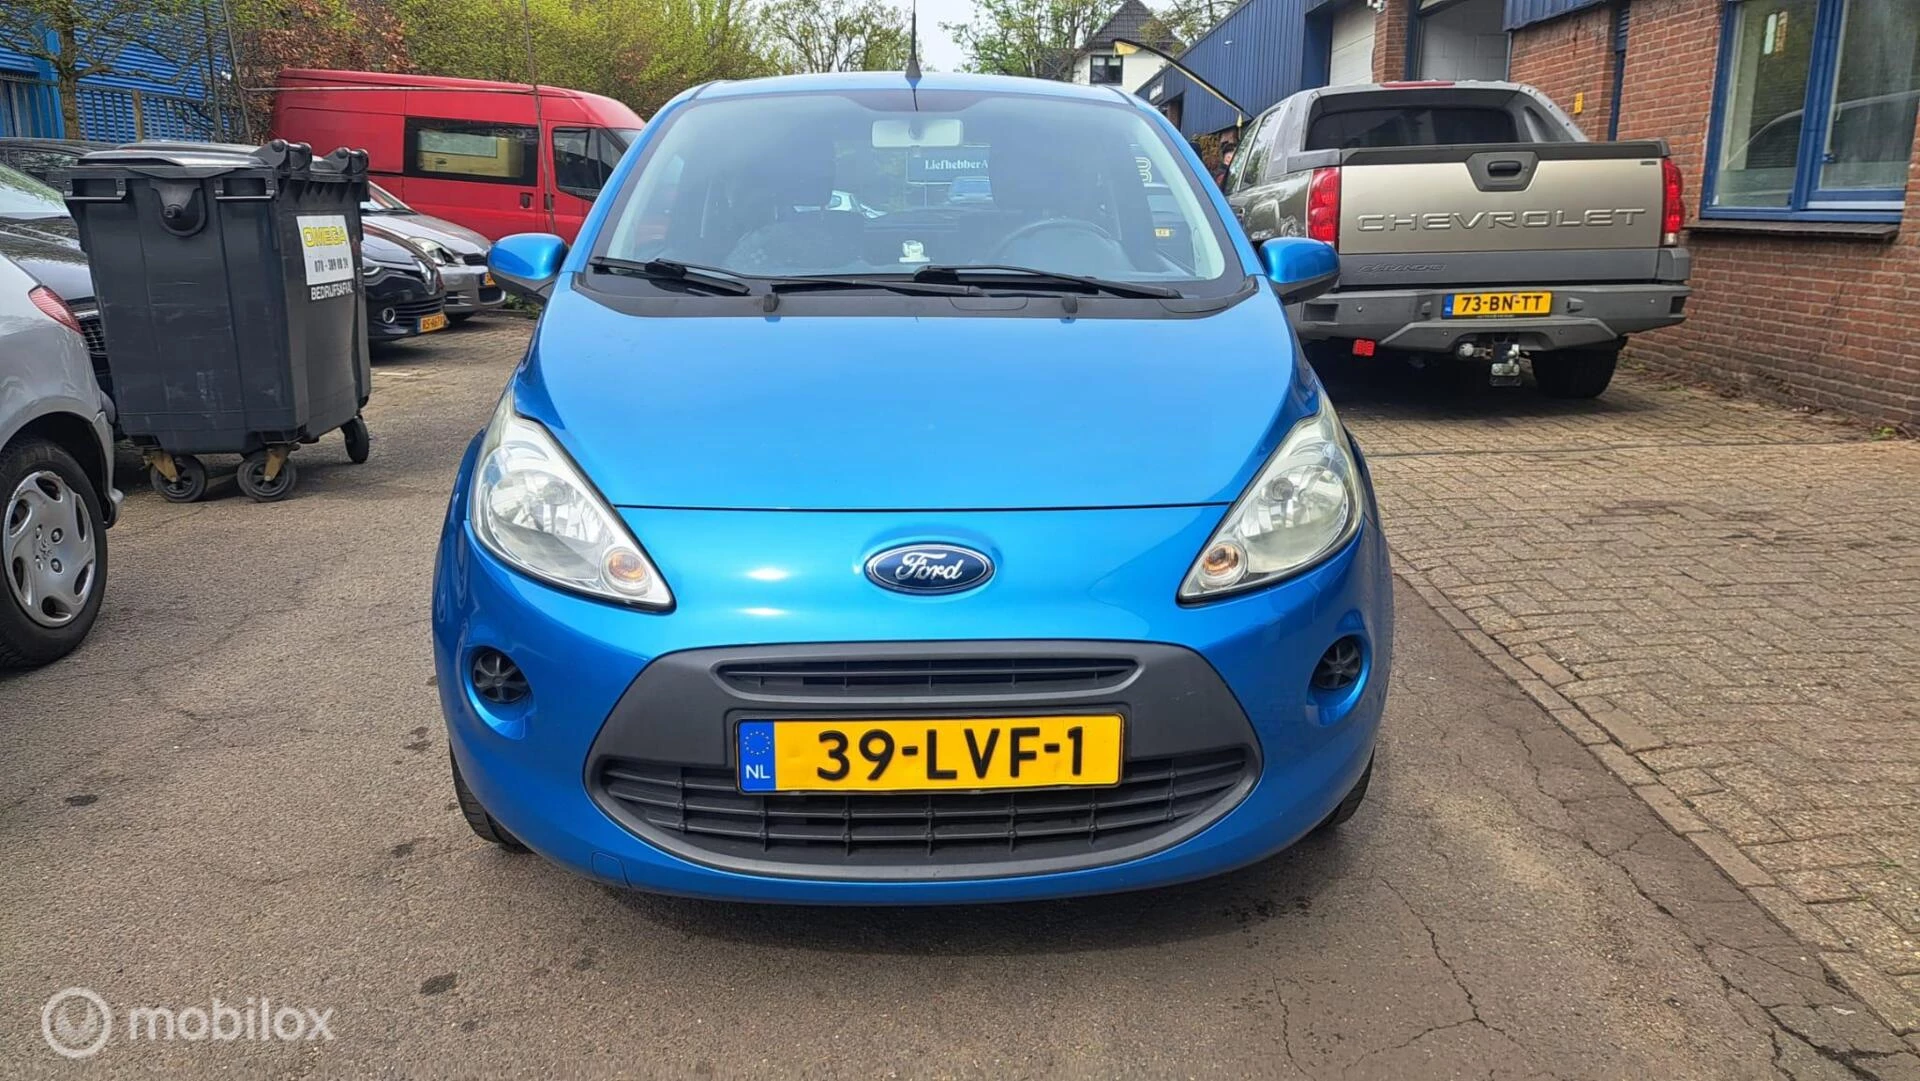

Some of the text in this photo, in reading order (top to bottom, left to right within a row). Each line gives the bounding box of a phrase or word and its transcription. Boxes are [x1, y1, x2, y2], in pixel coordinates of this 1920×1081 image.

[1357, 208, 1646, 232] CHEVROLET
[303, 226, 347, 248] OMEGA
[1461, 295, 1544, 313] 73-BN-TT
[895, 552, 964, 580] Ford
[816, 726, 1084, 781] 39-LVF-1
[745, 764, 771, 780] NL
